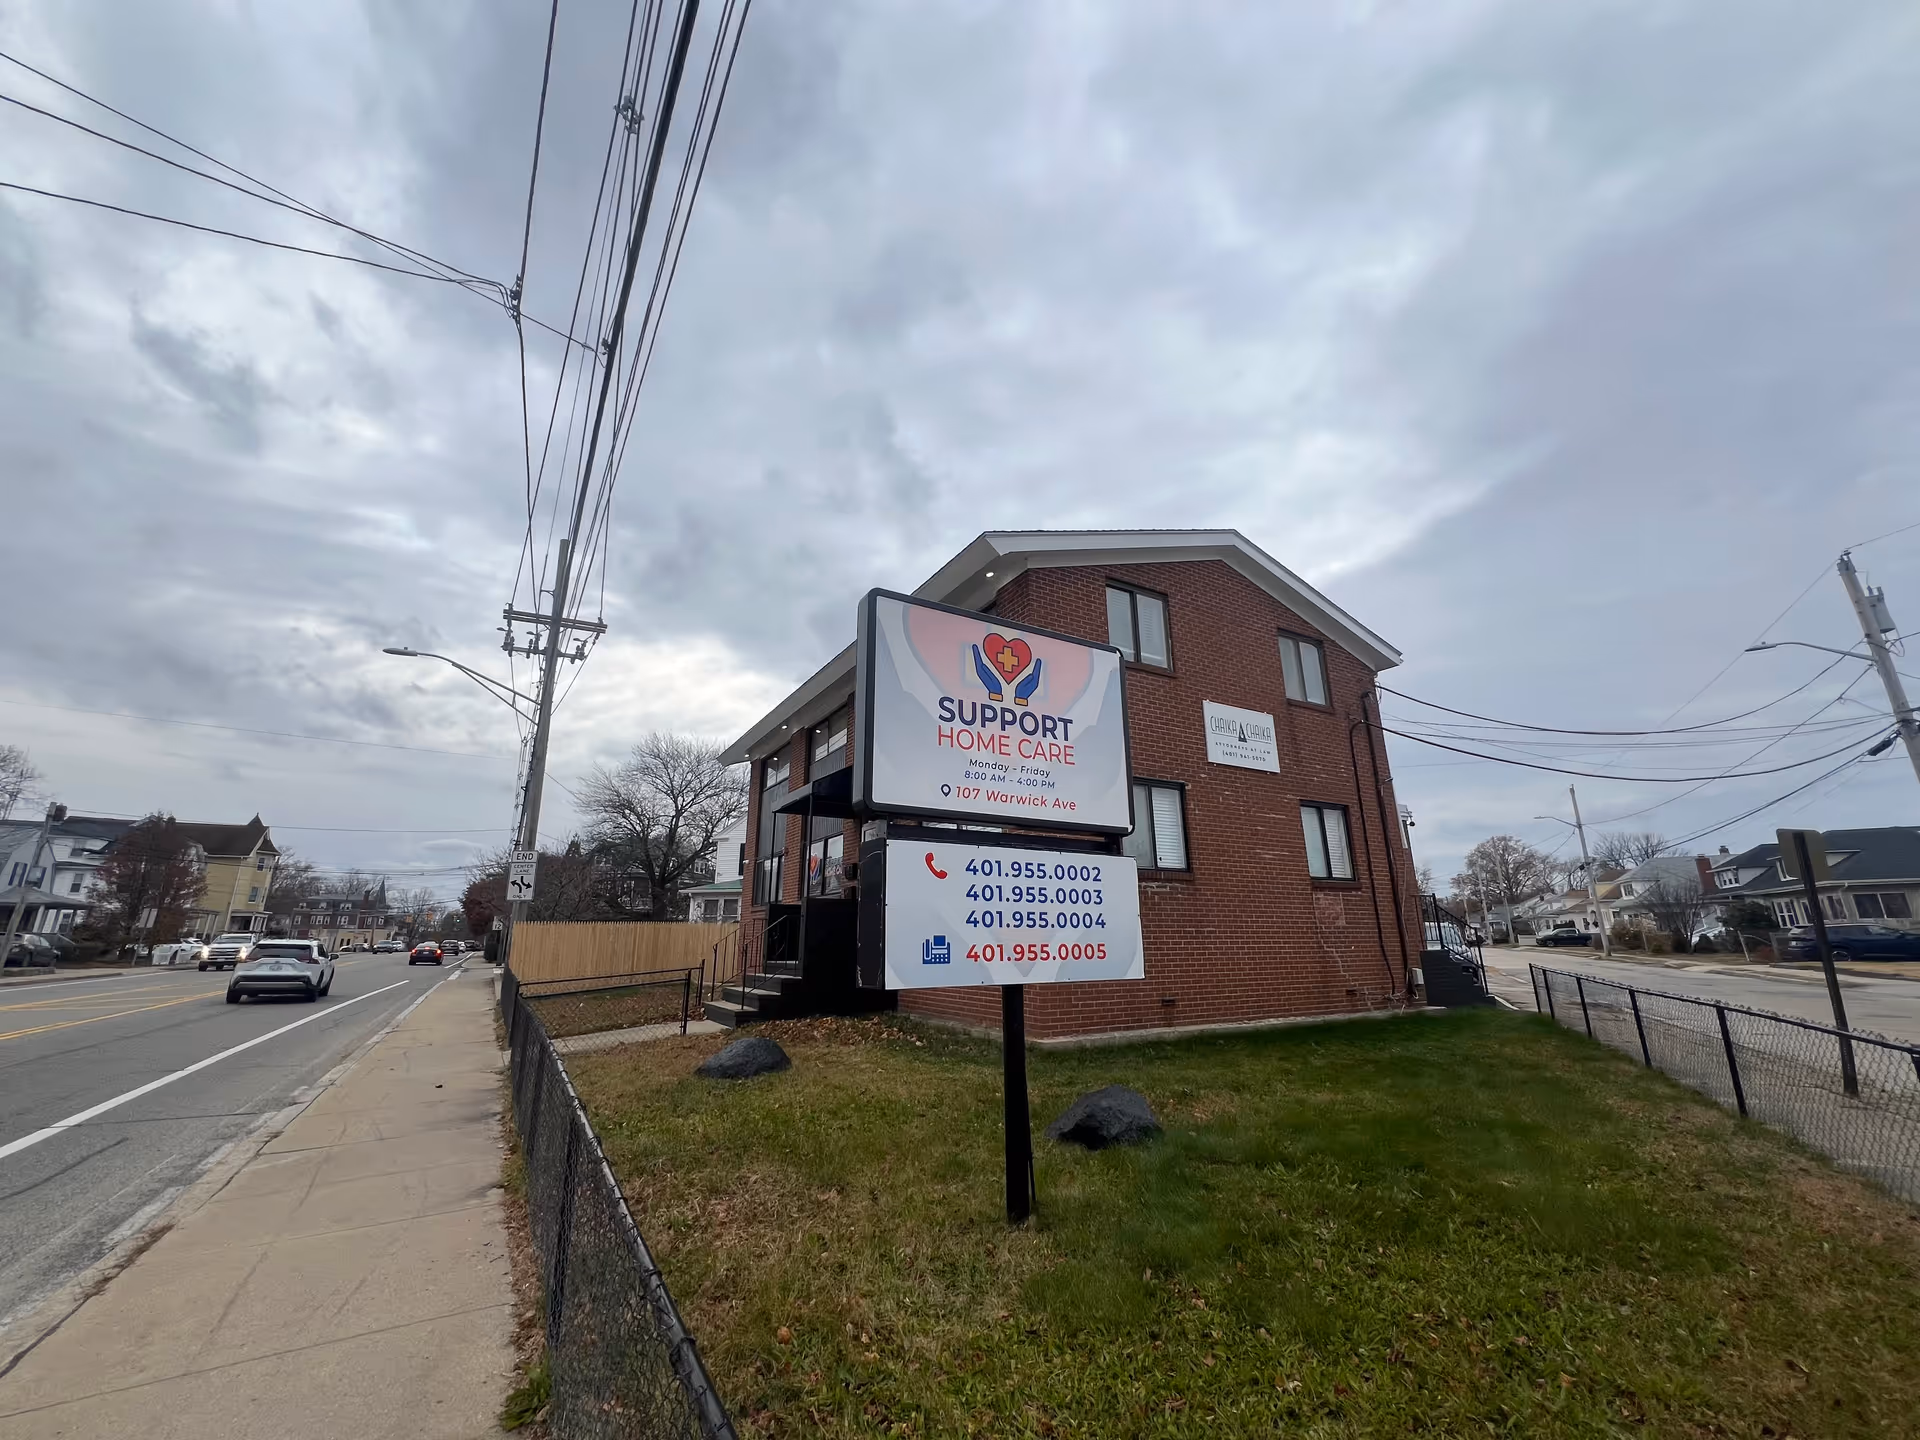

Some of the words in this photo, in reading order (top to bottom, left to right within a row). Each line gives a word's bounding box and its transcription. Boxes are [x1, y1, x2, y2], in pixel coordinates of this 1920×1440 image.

[938, 696, 1073, 741] SUPPORT
[1210, 716, 1237, 735] CHAIKA
[1246, 723, 1272, 742] CHAIKA
[937, 724, 1011, 757] HOME
[1017, 738, 1076, 766] CARE
[969, 758, 1010, 773] Monday
[1020, 766, 1051, 778] Friday
[964, 770, 987, 781] 8:00
[989, 774, 1006, 783] AM
[1017, 778, 1038, 787] 4:00
[1041, 781, 1056, 789] PM
[956, 786, 981, 800] 107
[986, 790, 1048, 808] Warwick
[1051, 797, 1076, 811] Ave
[516, 852, 534, 861] END
[965, 858, 1102, 882] 401.955.0002
[965, 884, 1103, 905] 401.955.0003
[965, 910, 1107, 929] 401.955.0004
[966, 943, 1107, 963] 401.955.0005
